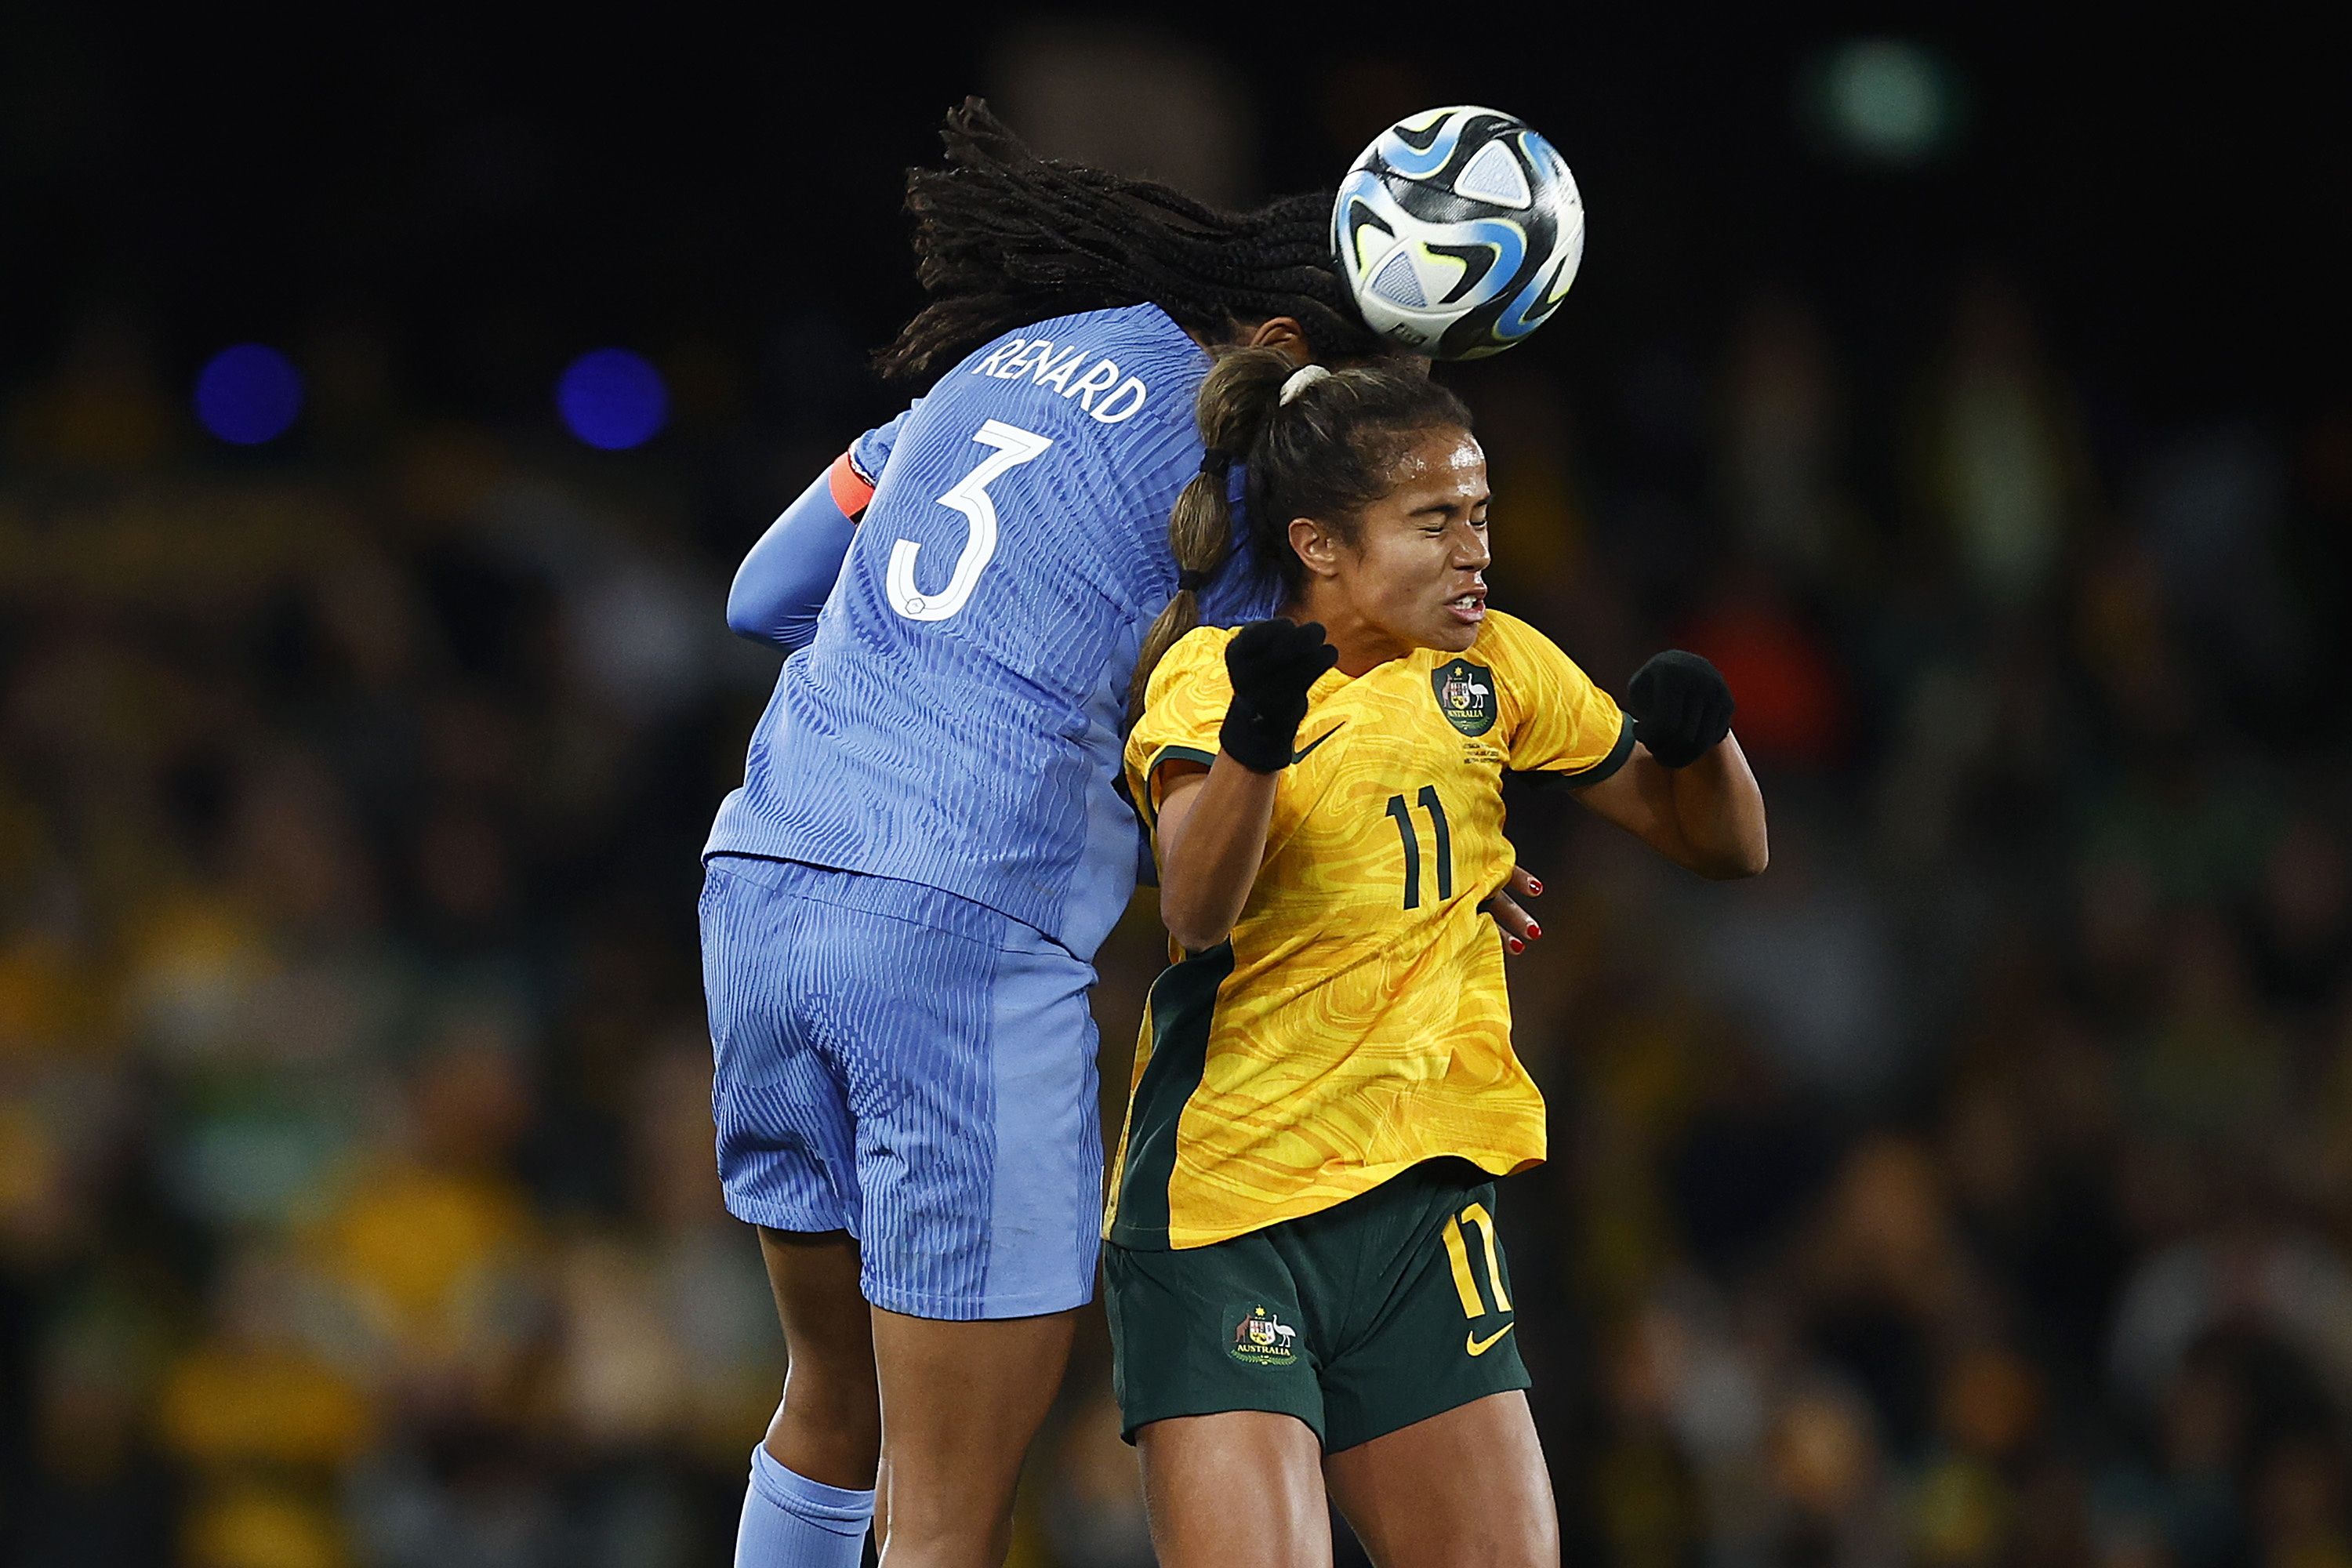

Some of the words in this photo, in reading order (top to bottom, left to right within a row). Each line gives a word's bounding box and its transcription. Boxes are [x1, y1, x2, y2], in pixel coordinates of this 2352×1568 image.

[972, 339, 1146, 423] RENARD
[886, 419, 1054, 622] 3
[1385, 784, 1452, 911] 11
[1441, 1202, 1512, 1319] 11
[1237, 1344, 1291, 1356] AUSTRALIA
